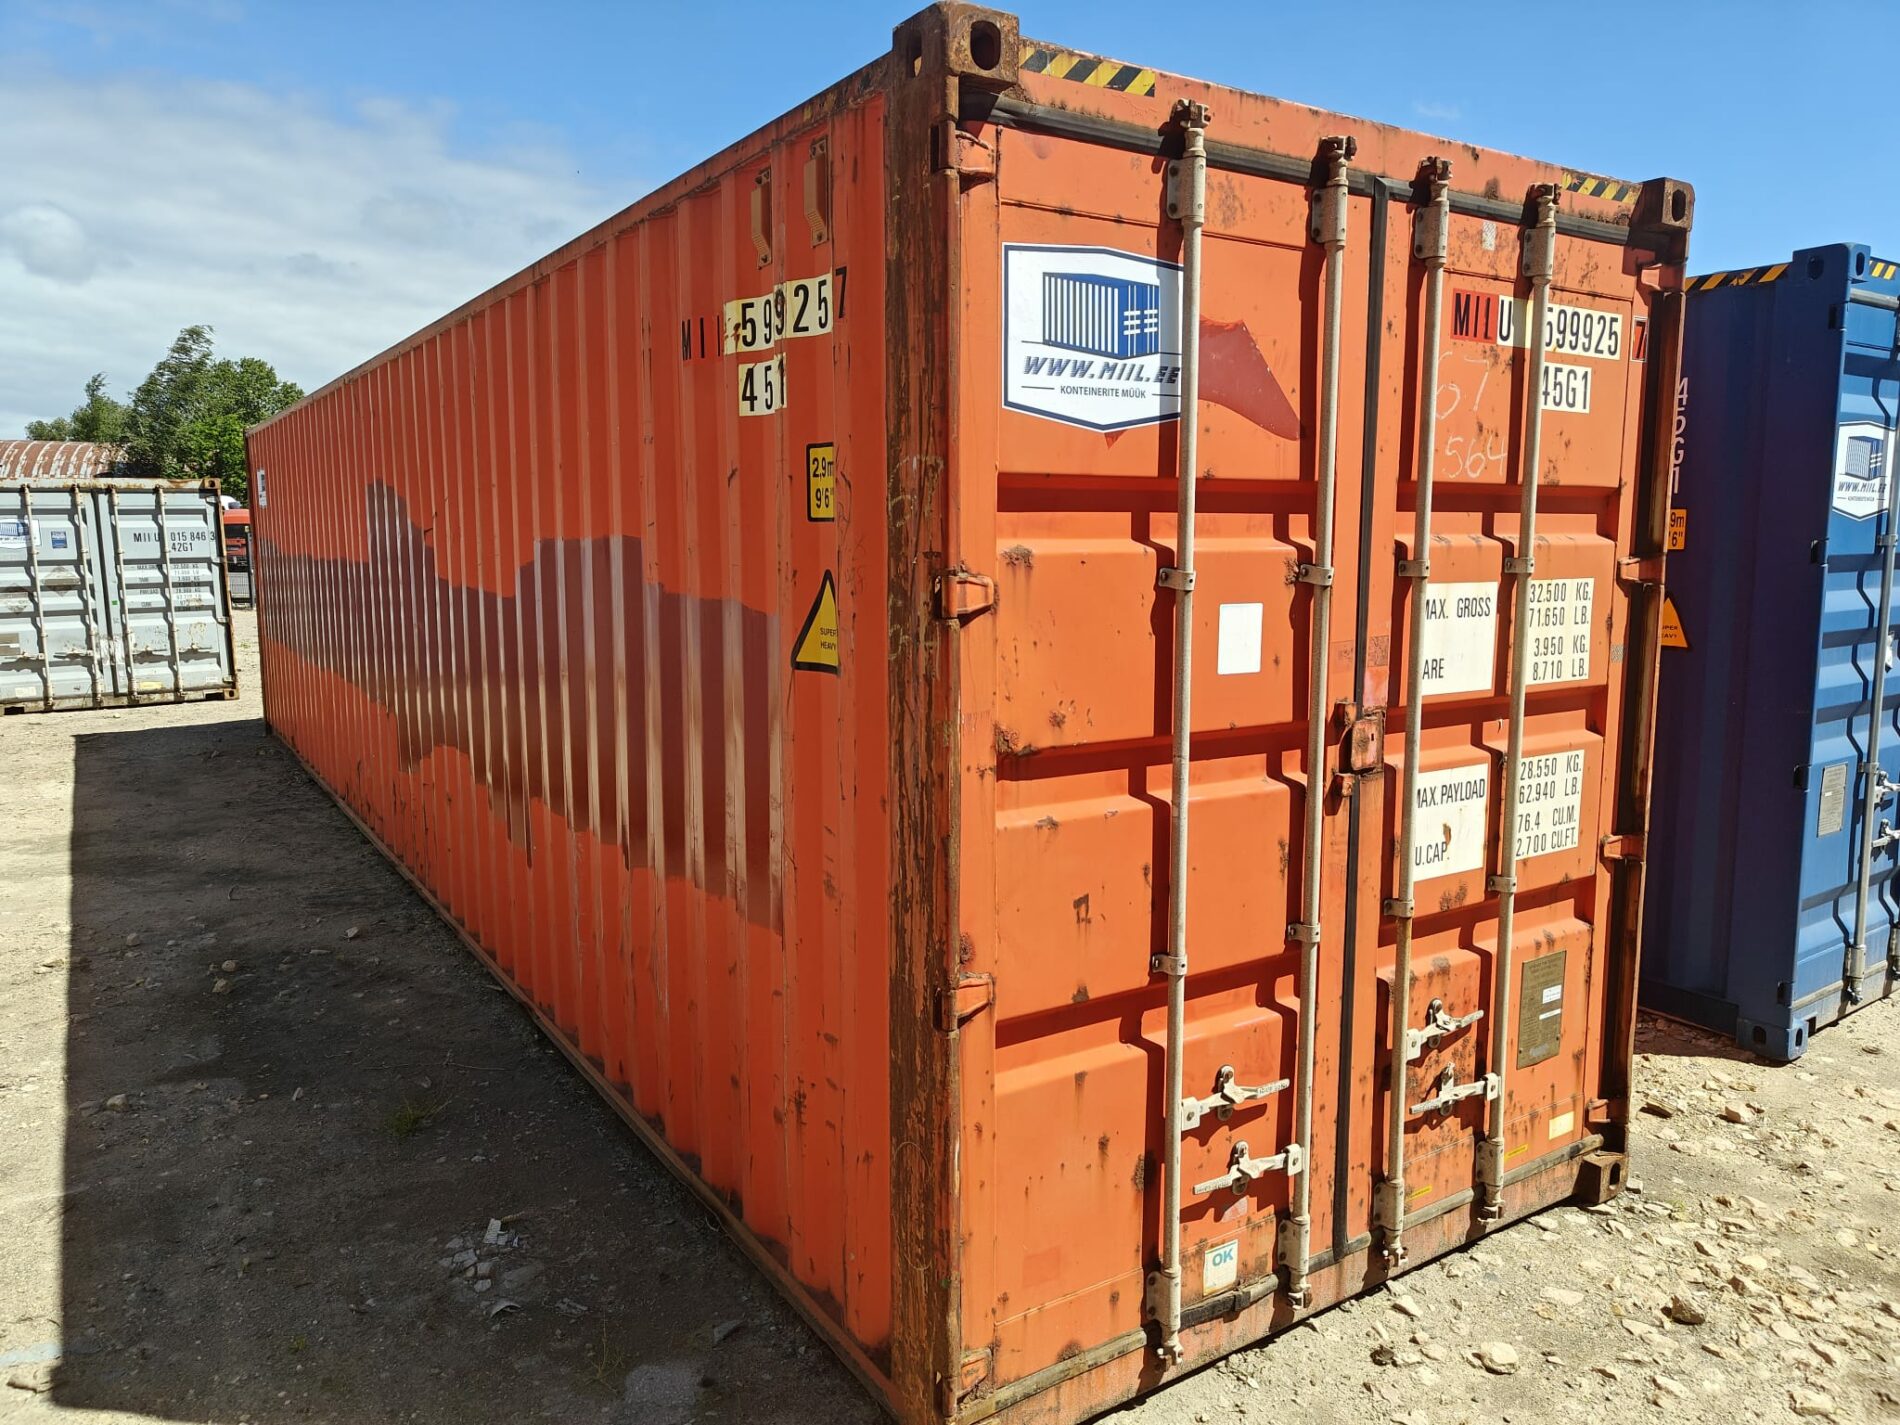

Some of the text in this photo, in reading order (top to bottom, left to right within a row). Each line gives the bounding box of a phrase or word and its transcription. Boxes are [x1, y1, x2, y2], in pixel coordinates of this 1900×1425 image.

[835, 267, 847, 319] 7
[1634, 320, 1646, 359] 7
[1024, 356, 1181, 384] WWW.MIIL.EE
[1060, 385, 1147, 400] KONTEINERITE MÜÜK
[1542, 365, 1588, 410] 45G1
[1670, 511, 1685, 528] 9m
[1529, 581, 1591, 603] 32.500 KG.
[1456, 596, 1491, 618] GROSS
[1529, 605, 1589, 628] 71.650 LB.
[1534, 634, 1588, 657] 3.950 KG.
[1422, 657, 1445, 680] ARE
[1532, 658, 1587, 681] 8.710 LB.
[1520, 754, 1582, 781] 28.550 KG.
[1440, 778, 1485, 805] PAYLOAD
[1519, 777, 1580, 805] 62.940 LB.
[1517, 804, 1577, 834] 76.4 CU.M.
[1414, 841, 1450, 867] U.CAP.
[1515, 826, 1577, 858] 2.700 CU.FT.
[1212, 1248, 1234, 1267] OK
